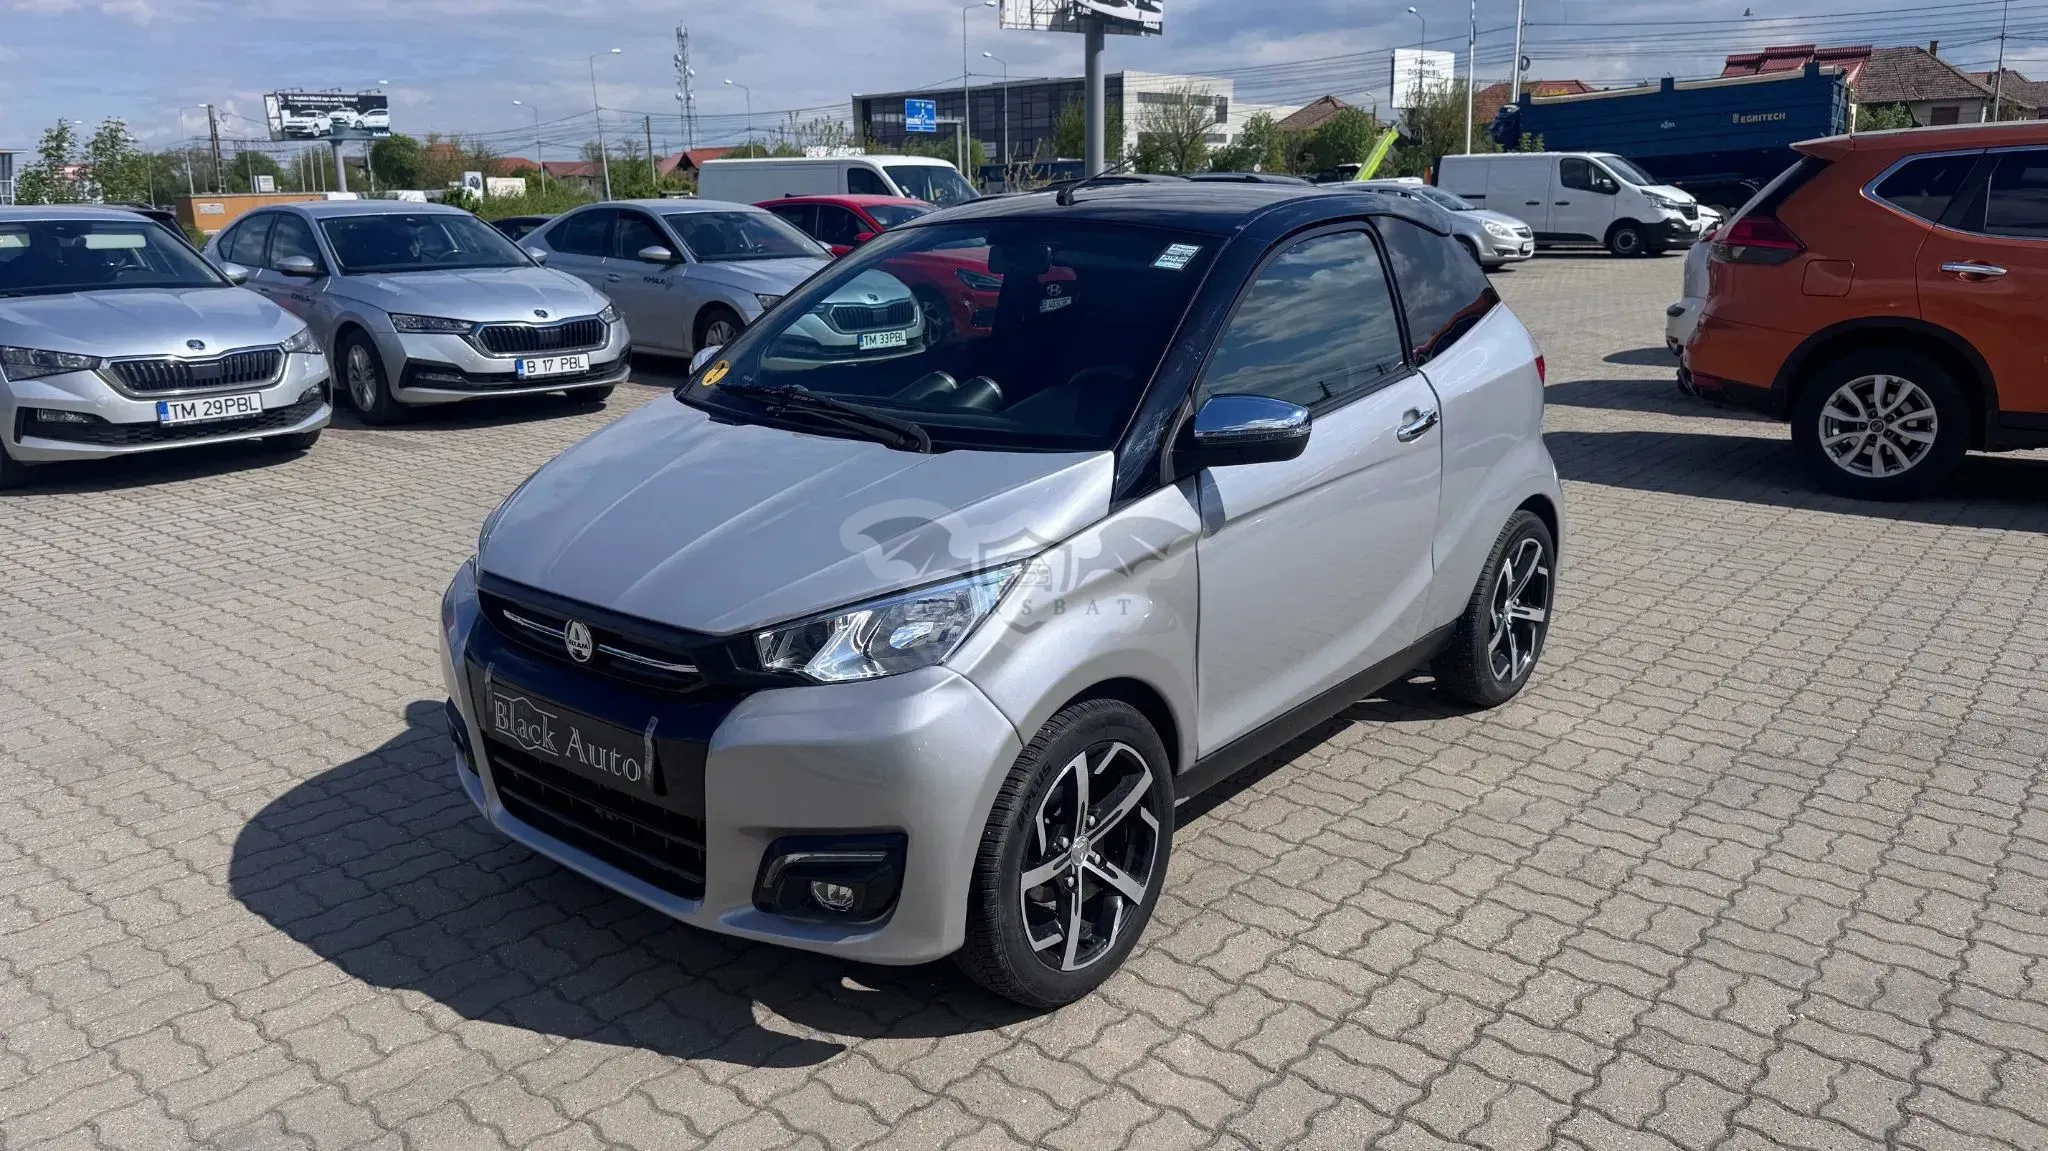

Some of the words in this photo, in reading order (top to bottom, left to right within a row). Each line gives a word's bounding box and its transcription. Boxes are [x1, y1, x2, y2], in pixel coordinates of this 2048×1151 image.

[1740, 112, 1786, 123] EGRITECH
[863, 335, 877, 346] TM
[526, 360, 536, 373] B
[542, 359, 554, 372] 17
[560, 356, 585, 370] PBL
[170, 402, 197, 419] TM
[203, 396, 259, 416] 29PBL
[494, 699, 558, 752] Black
[565, 725, 641, 782] Auto
